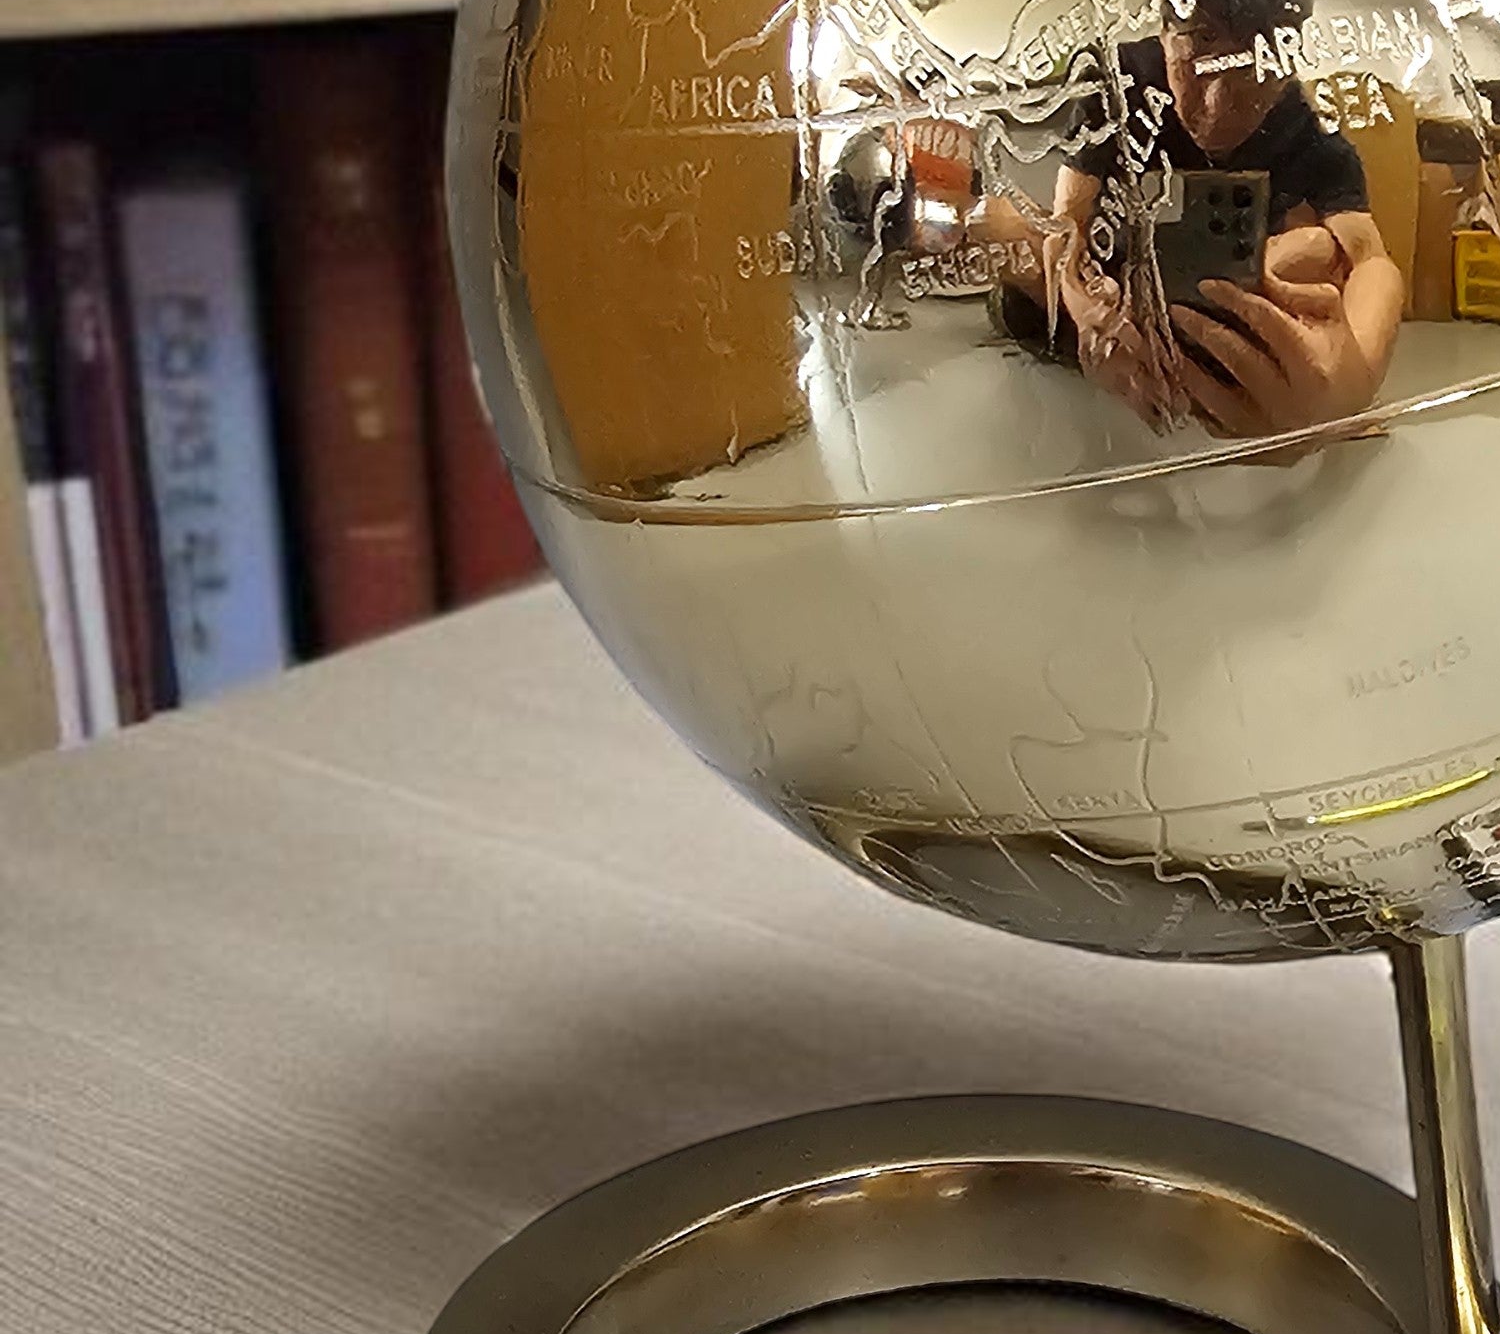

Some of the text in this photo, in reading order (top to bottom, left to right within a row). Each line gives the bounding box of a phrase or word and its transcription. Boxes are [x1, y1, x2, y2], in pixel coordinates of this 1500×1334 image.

[1253, 7, 1433, 84] ARABIAN
[648, 74, 779, 120] AFRICA
[1313, 73, 1395, 134] SEA
[1306, 753, 1478, 812] SEYCHELLES
